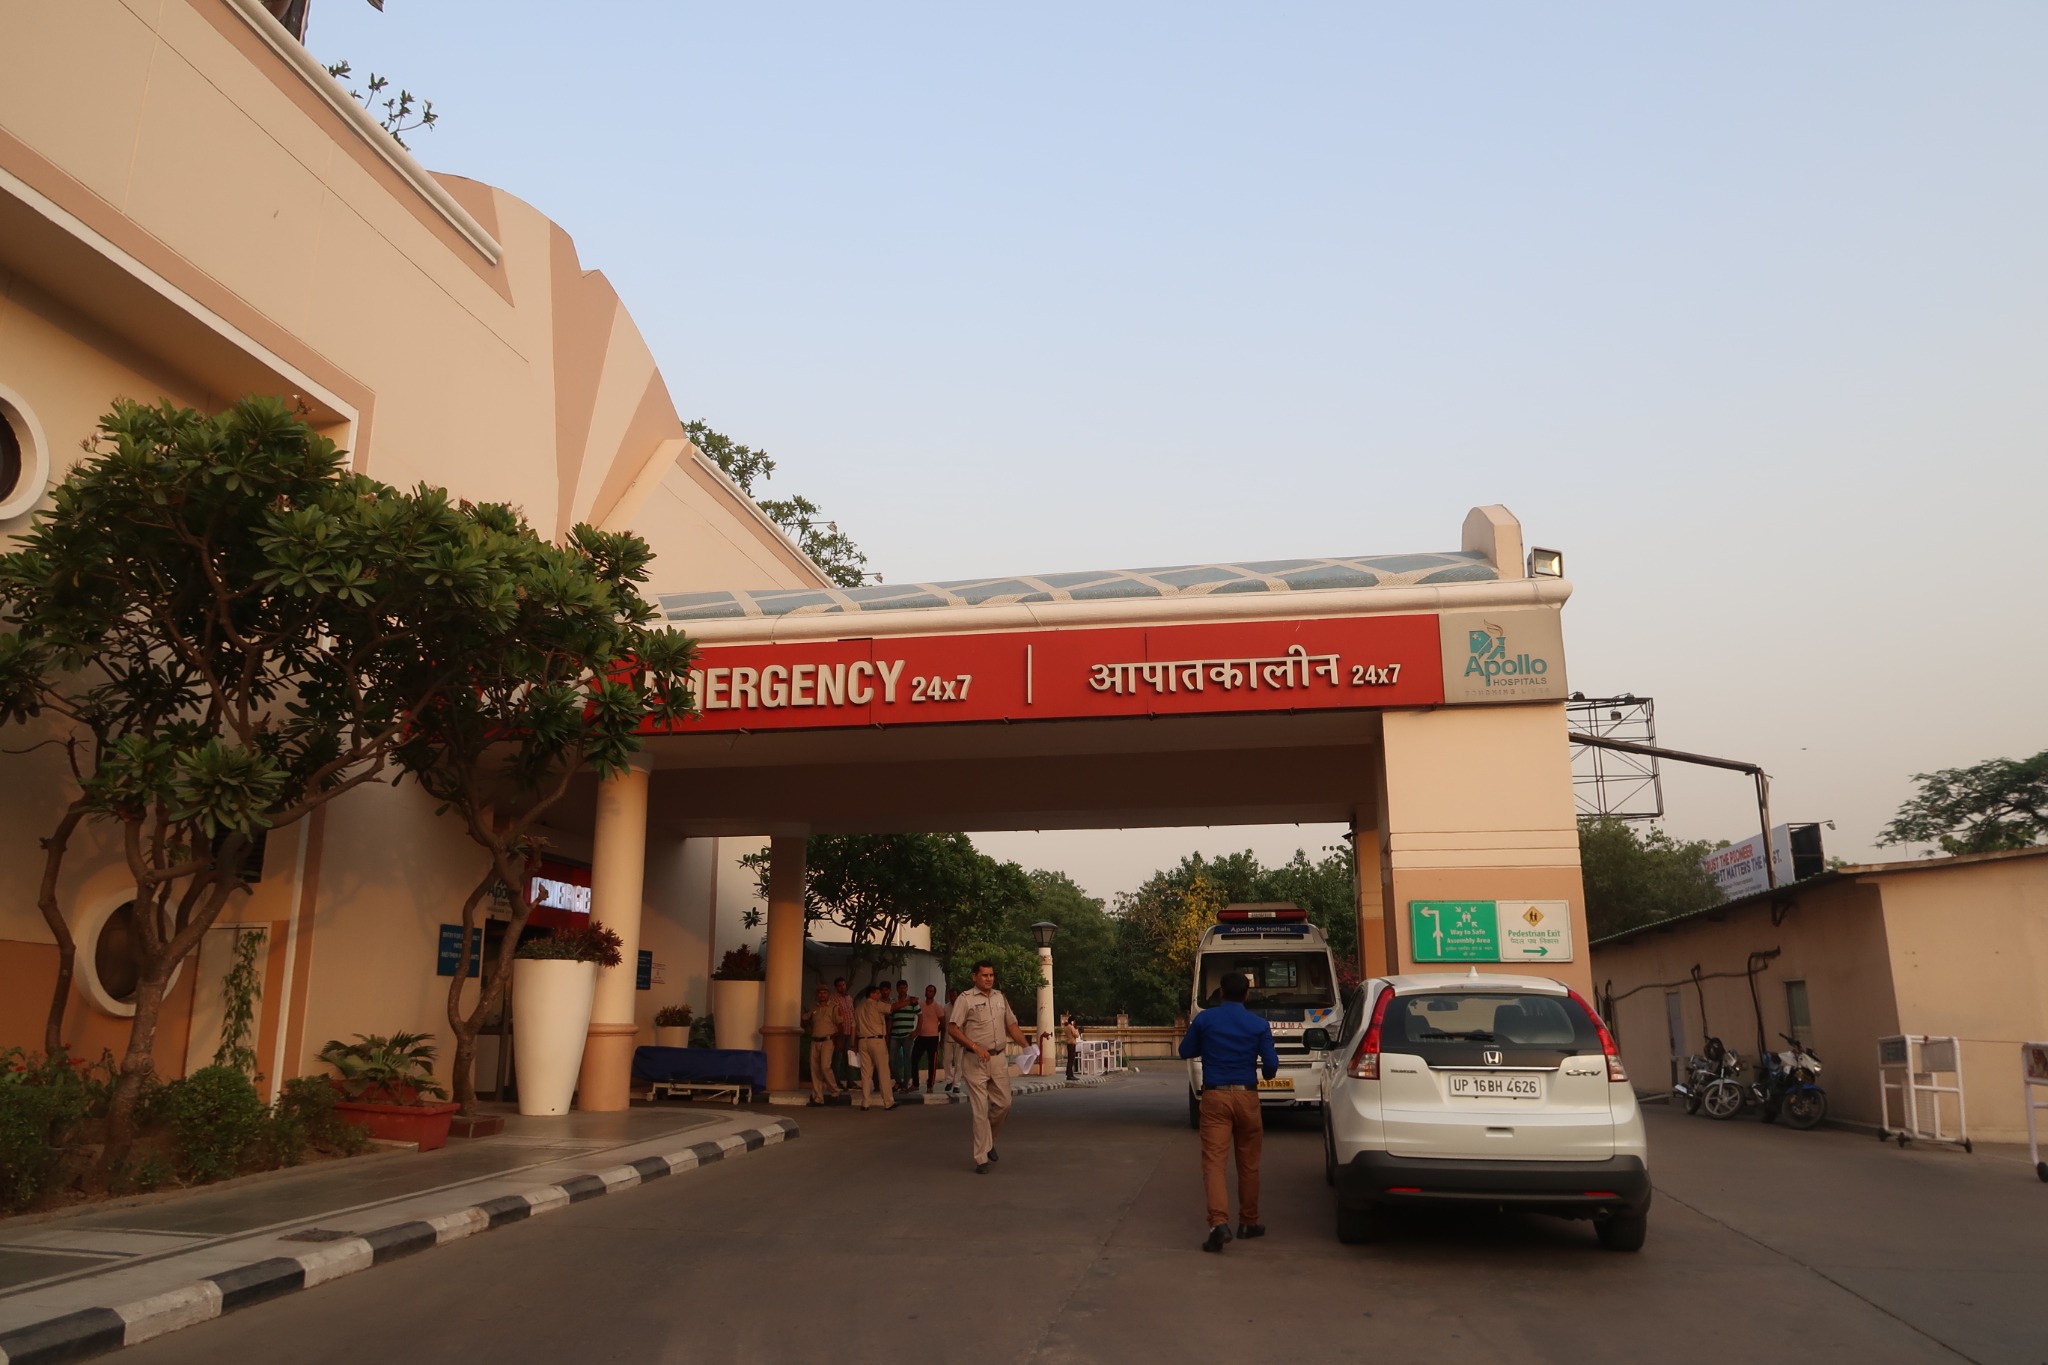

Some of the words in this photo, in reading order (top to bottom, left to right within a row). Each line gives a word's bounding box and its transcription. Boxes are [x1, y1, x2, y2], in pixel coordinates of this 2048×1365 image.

[1088, 644, 1341, 694] आपातकालीन
[1351, 663, 1401, 686] 24x7
[1464, 654, 1548, 687] Apollo
[911, 674, 973, 702] 24x7
[1493, 677, 1548, 687] HOSPITALS
[1719, 853, 1730, 866] THE
[1726, 861, 1751, 880] MATTERS
[1752, 856, 1763, 872] THE
[1508, 929, 1546, 937] Pedestrian
[1547, 929, 1561, 937] Exit
[1453, 1079, 1469, 1092] UP
[1506, 1080, 1537, 1093] 4626
